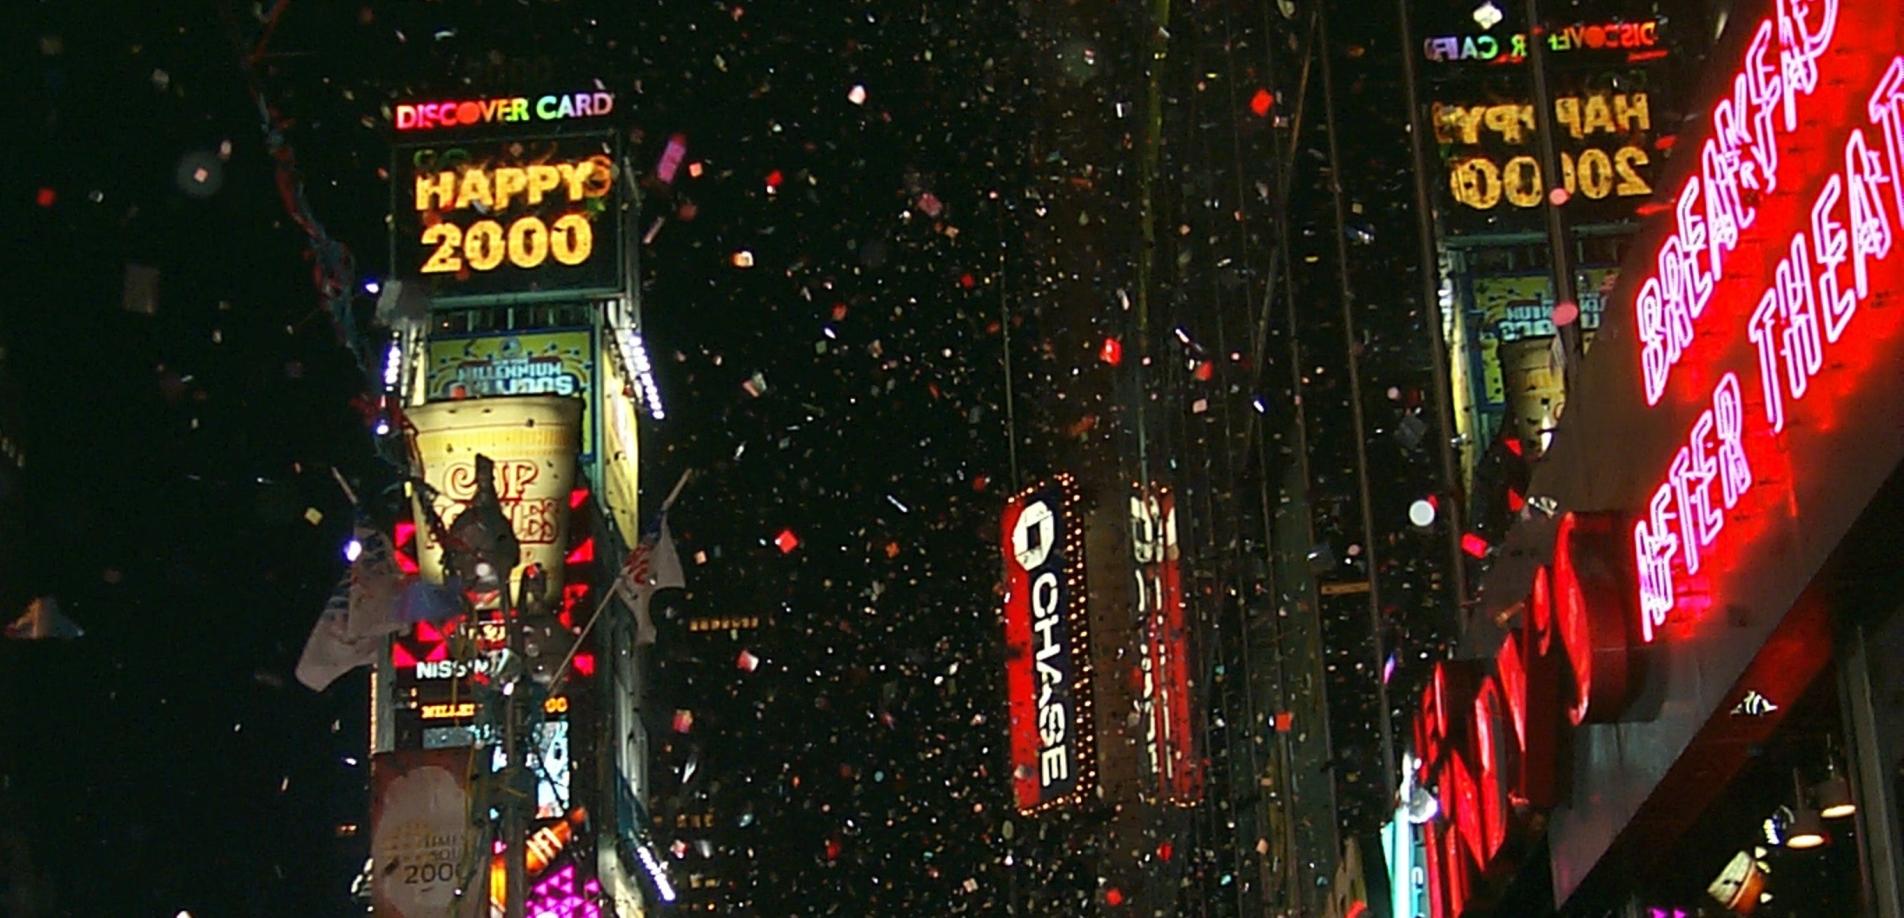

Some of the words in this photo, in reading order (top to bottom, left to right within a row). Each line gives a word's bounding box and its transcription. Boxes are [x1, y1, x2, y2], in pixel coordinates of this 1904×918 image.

[396, 98, 530, 130] DISCOVER
[536, 92, 613, 121] CARD
[416, 161, 594, 211] HAPPY
[420, 214, 593, 274] 2000
[1635, 372, 1752, 643] AFTER
[1031, 571, 1068, 788] CHASE
